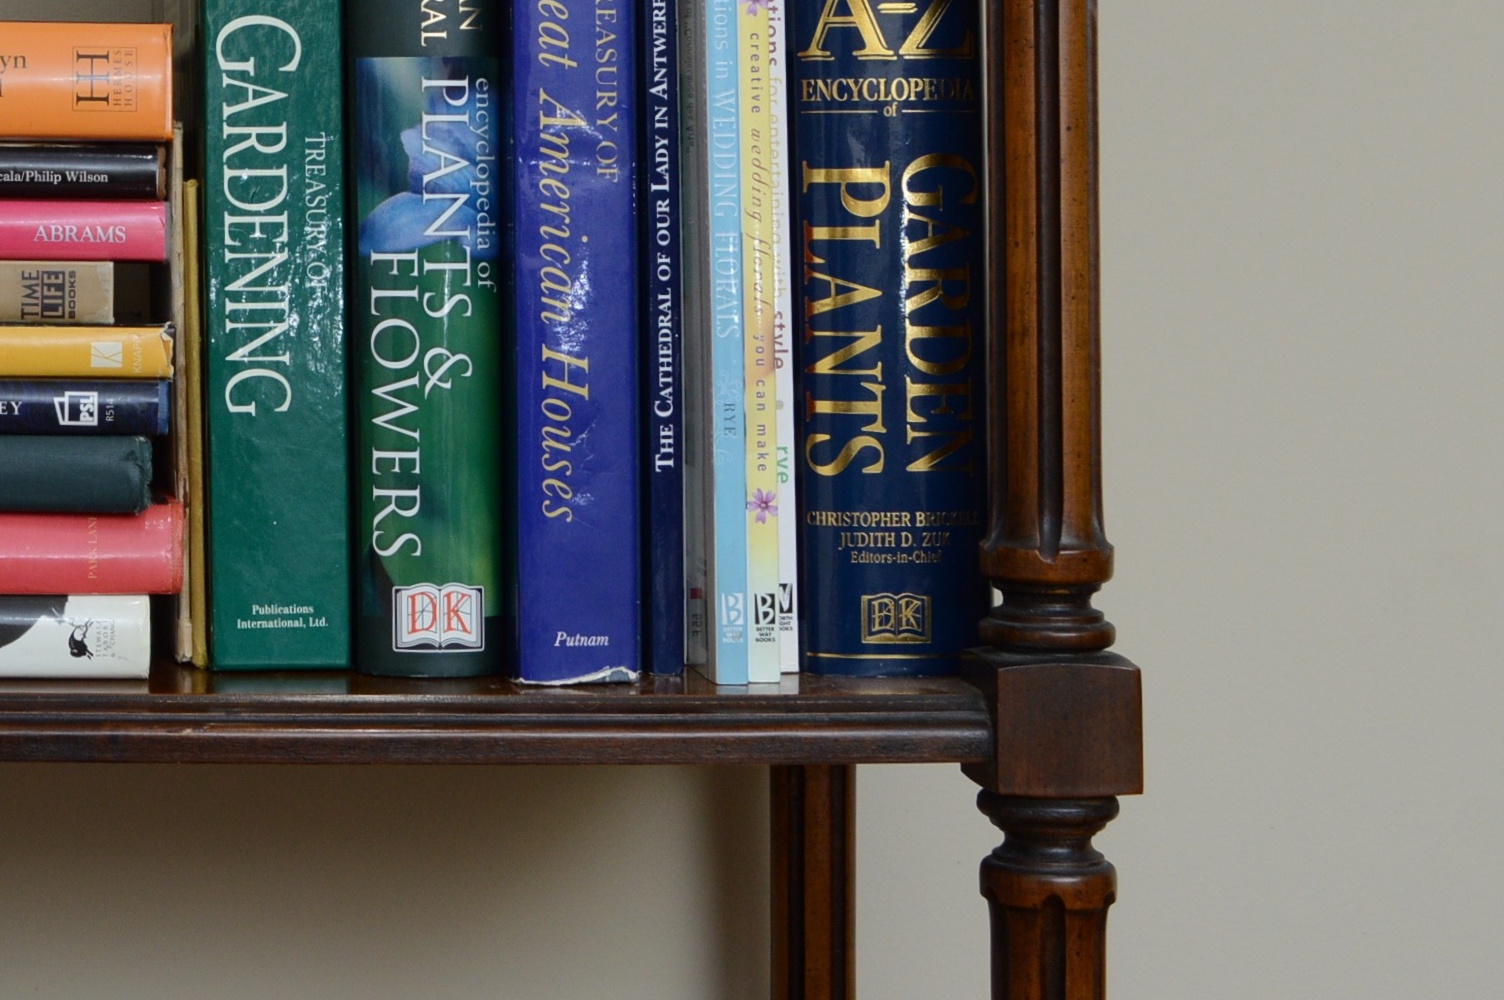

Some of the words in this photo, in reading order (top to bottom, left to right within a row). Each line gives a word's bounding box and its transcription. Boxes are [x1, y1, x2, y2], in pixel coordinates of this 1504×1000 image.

[113, 50, 122, 106] HERMES
[715, 61, 732, 79] in
[749, 32, 763, 114] creative
[655, 105, 669, 136] IN
[883, 102, 898, 117] of
[470, 77, 496, 250] encyclopedia
[596, 140, 619, 183] OF
[651, 138, 670, 193] LADY
[713, 89, 738, 218] WEDDING
[744, 128, 769, 223] wedding
[64, 171, 109, 184] Wilson
[305, 131, 327, 253] TREASURY
[422, 75, 472, 318] PLANTS
[216, 15, 302, 416] GARDENING
[539, 87, 589, 324] American
[656, 198, 670, 246] OUR
[33, 225, 126, 244] ABRAMS
[306, 261, 329, 294] OF
[477, 262, 497, 292] of
[656, 252, 671, 282] OF
[715, 231, 740, 338] FLORALS
[21, 270, 39, 320] TIME
[42, 271, 65, 318] LIFE
[68, 270, 76, 319] BOOKS
[802, 160, 892, 476] PLANTS
[901, 153, 978, 476] GARDEN
[423, 347, 473, 399] &
[654, 287, 673, 418] CATHEDRAL
[753, 335, 766, 367] you
[79, 396, 94, 422] PSL
[370, 248, 422, 557] FLOWERS
[755, 379, 766, 411] can
[541, 344, 589, 522] Houses
[723, 403, 736, 436] RYE
[655, 425, 674, 473] THE
[756, 424, 769, 471] make
[776, 446, 789, 484] rye
[807, 511, 912, 527] CHRISTOPHER
[838, 531, 896, 550] JUDITH
[900, 531, 916, 547] D.
[850, 550, 942, 564] Editors-in-Chief
[237, 618, 306, 629] International,
[309, 616, 329, 627] Ltd.
[252, 604, 314, 615] Publications
[408, 591, 472, 636] DK
[554, 631, 609, 647] Putnam
